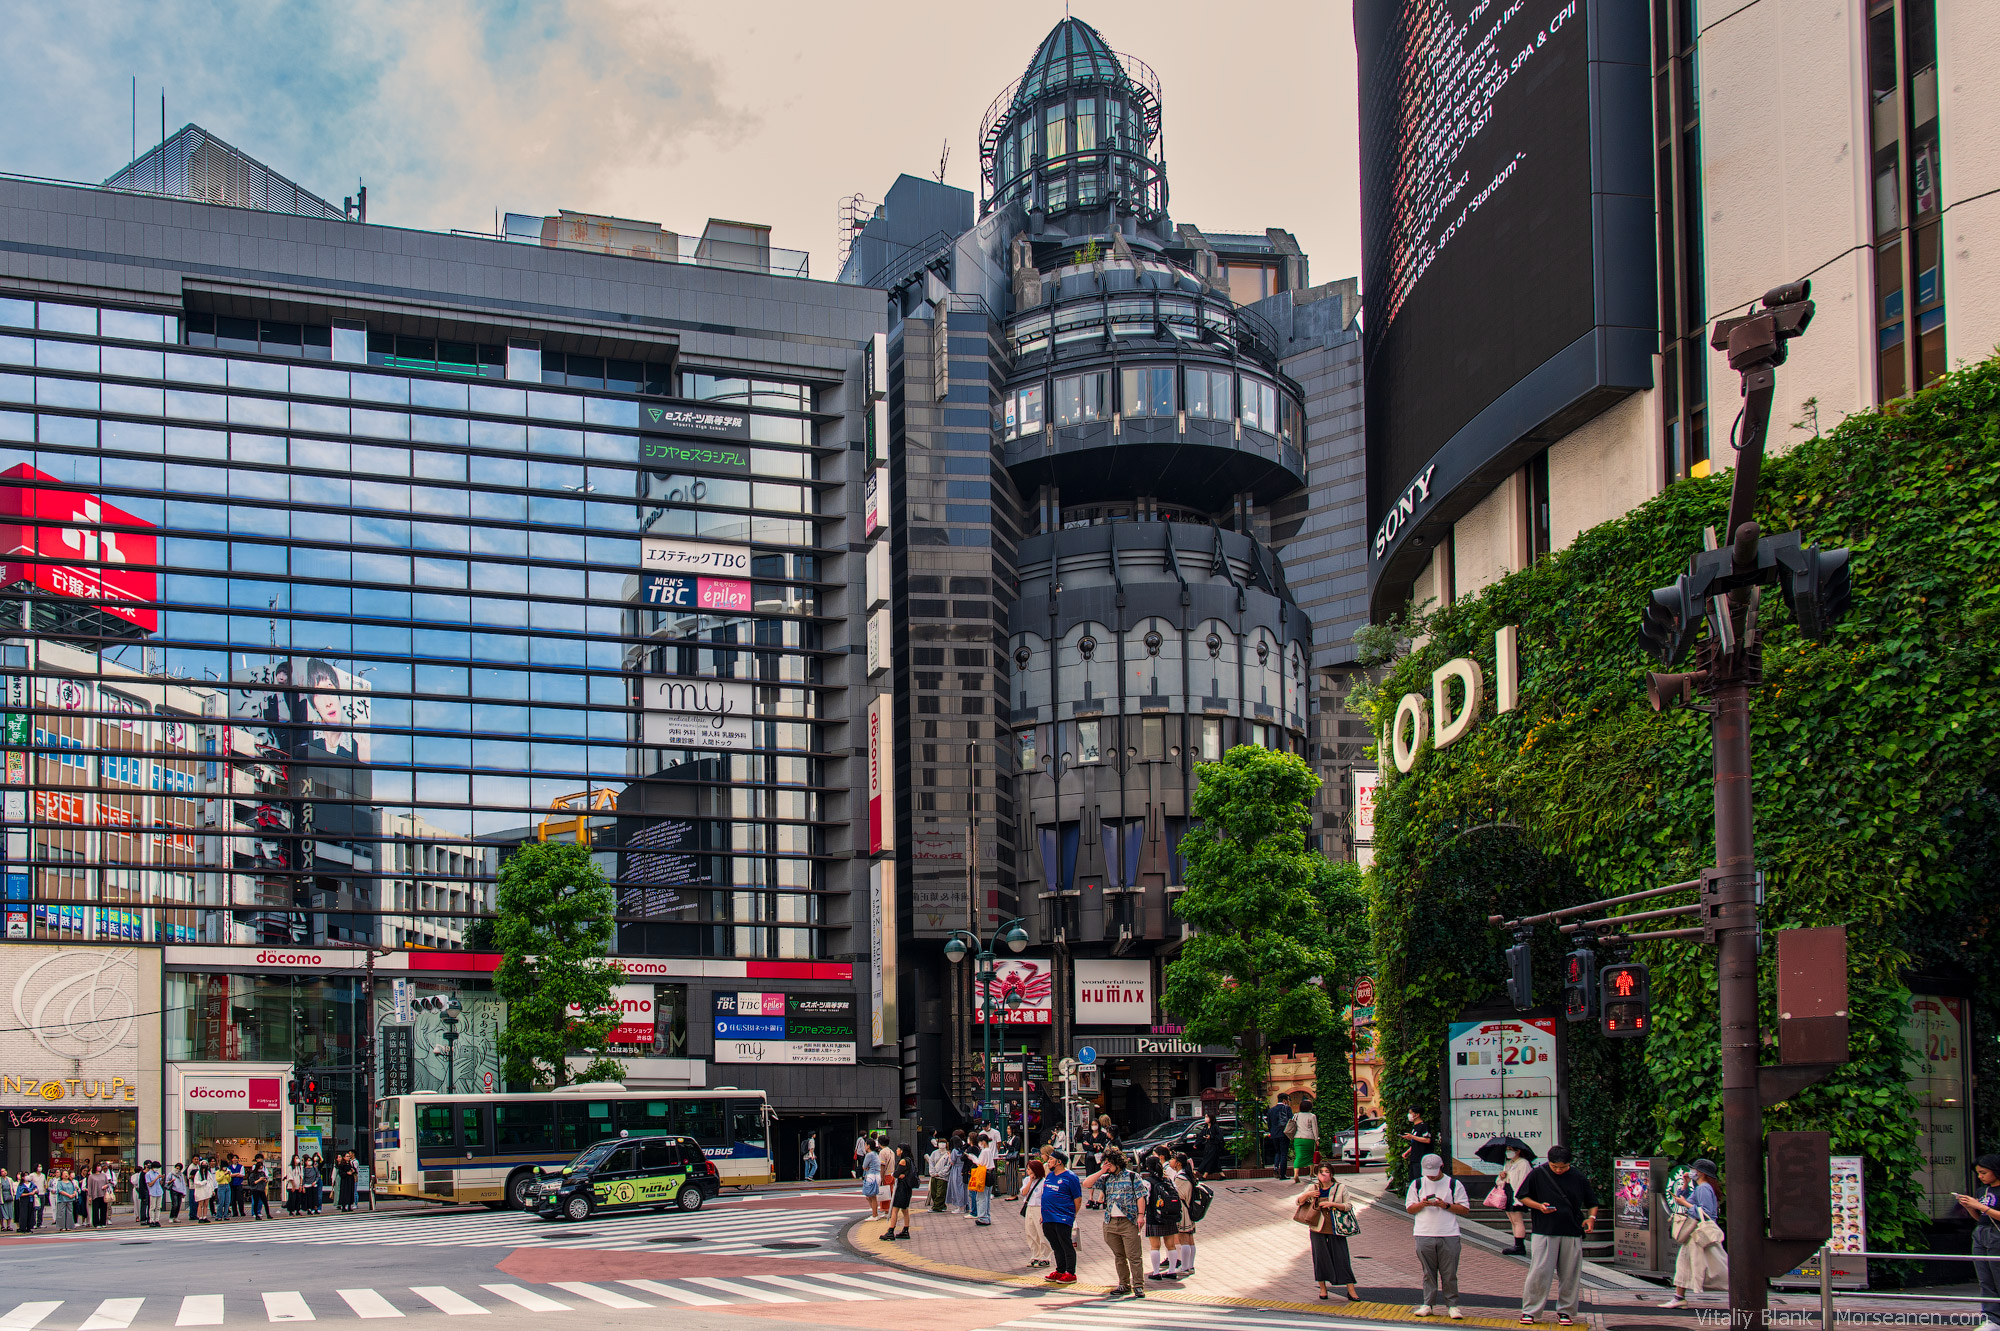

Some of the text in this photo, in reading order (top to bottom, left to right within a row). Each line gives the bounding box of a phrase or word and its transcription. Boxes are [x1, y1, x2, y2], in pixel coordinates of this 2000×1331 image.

[1418, 11, 1452, 65] Theaters.
[1414, 63, 1428, 90] and
[1428, 20, 1456, 67] Digital.
[1422, 76, 1431, 94] to
[1431, 23, 1468, 78] Theaters
[1435, 19, 1502, 109] Entertainment
[1503, 0, 1525, 25] Inc.
[1421, 85, 1435, 114] and
[1436, 45, 1466, 92] Digital.
[1427, 118, 1452, 156] Rights
[1453, 59, 1501, 122] Reserved.
[1434, 115, 1470, 166] MARVEL
[1482, 68, 1509, 107] 2023
[1510, 43, 1535, 76] SPA
[1536, 30, 1548, 49] &
[1418, 97, 1452, 153] Captured
[1453, 83, 1466, 103] on
[1439, 169, 1471, 214] Project
[1416, 245, 1437, 279] BASE
[1456, 207, 1468, 229] of
[665, 411, 743, 427] eスポーツ高等学院
[1376, 464, 1435, 560] SONY
[646, 548, 746, 569] エステティックTBC
[654, 577, 684, 587] MEN'S
[648, 585, 690, 605] TBC
[703, 585, 747, 608] épiler
[660, 682, 733, 729] my
[669, 728, 681, 736] 内科
[870, 712, 878, 790] docomo
[256, 951, 322, 965] docomo
[608, 959, 667, 973] docomo
[1082, 985, 1144, 1003] HUMAX
[716, 1001, 736, 1010] TBC
[740, 1002, 760, 1010] TBC
[800, 1001, 849, 1009] eスポーツ高等学院
[735, 1042, 765, 1061] my
[1137, 1038, 1202, 1054] Pavilion
[65, 1077, 135, 1101] TULPE
[189, 1086, 246, 1098] docomo
[20, 1111, 100, 1128] Cosmetic & Beauty
[1931, 1124, 1953, 1133] ONLINE
[1467, 1131, 1542, 1139] 9DAYS GALLERY
[715, 1147, 733, 1156] BUS
[1930, 1155, 1957, 1165] GALLERY
